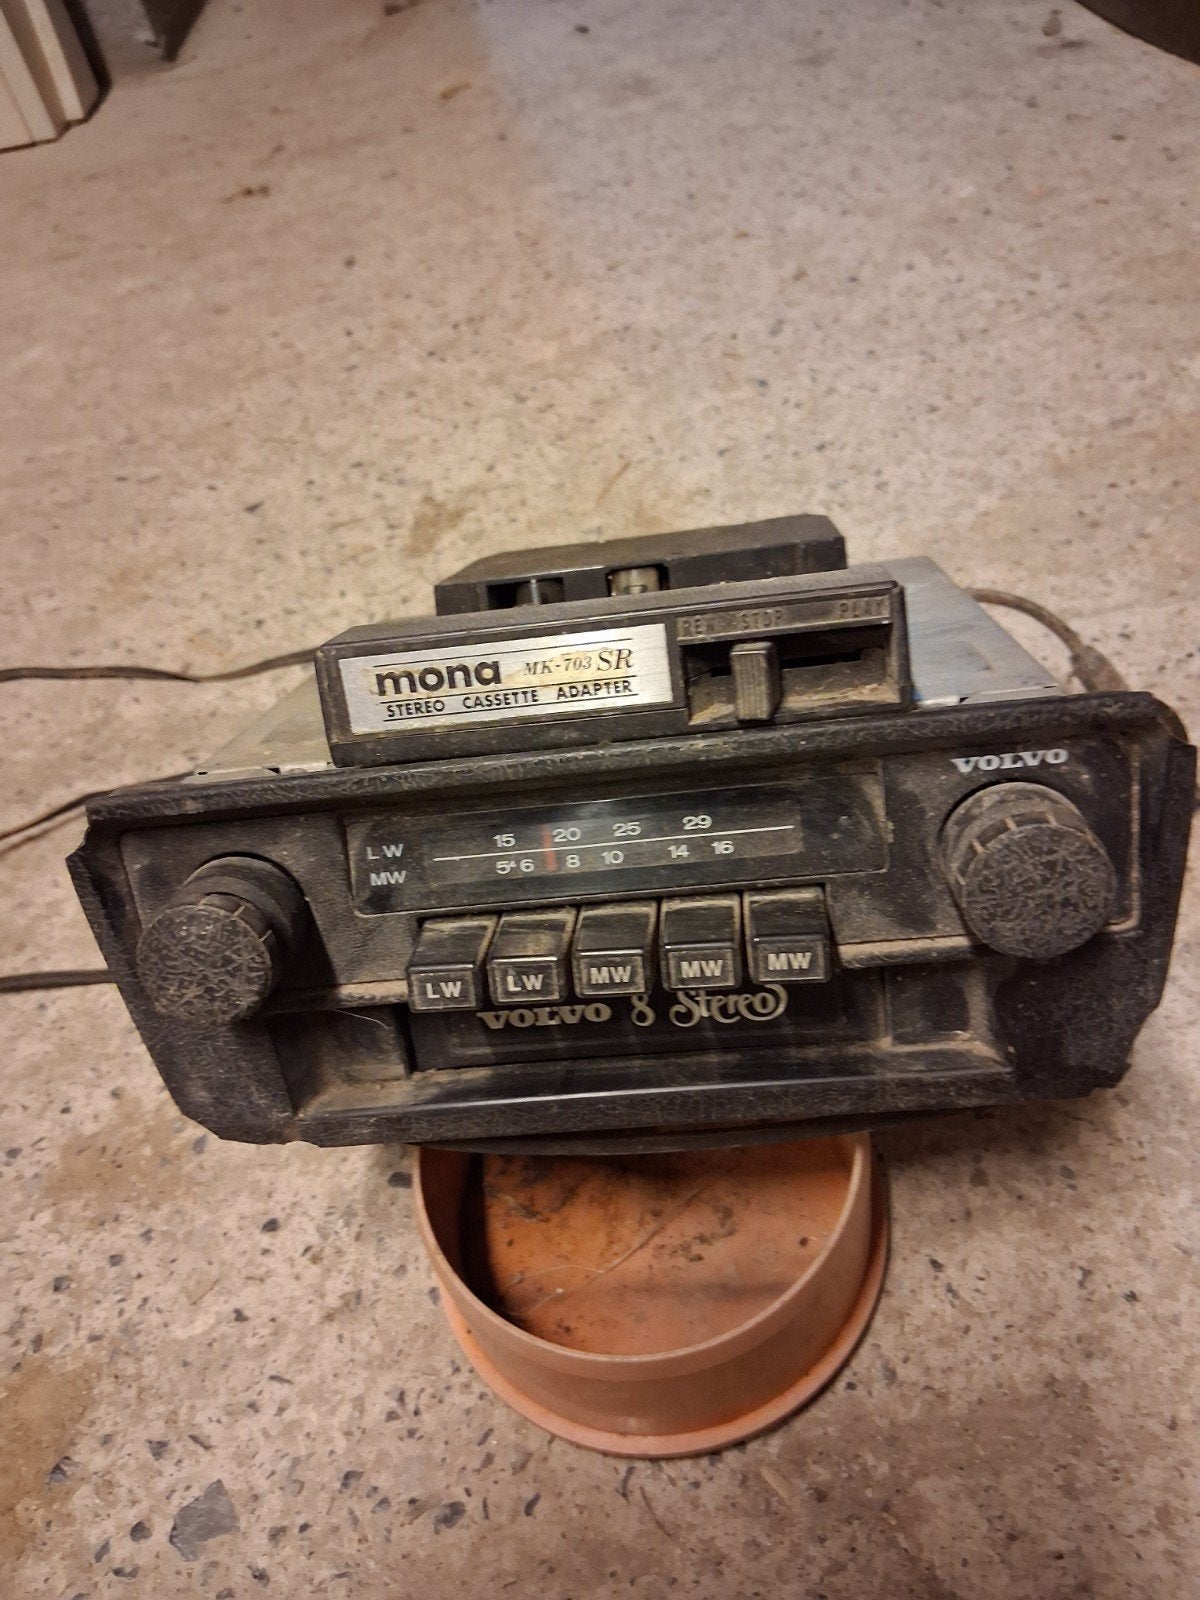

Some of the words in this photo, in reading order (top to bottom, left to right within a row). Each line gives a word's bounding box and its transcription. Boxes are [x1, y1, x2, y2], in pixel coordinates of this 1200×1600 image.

[597, 648, 633, 672] SR
[375, 659, 503, 696] mona
[386, 699, 445, 719] STEREO
[462, 689, 539, 710] CASSETTE
[556, 680, 634, 701] ADAPTER
[951, 748, 1069, 774] VOLVO
[493, 833, 516, 848] 15
[552, 827, 582, 843] 20
[612, 821, 642, 838] 25
[682, 814, 713, 831] 29
[366, 843, 404, 861] LW
[519, 859, 536, 873] 6
[565, 854, 581, 869] 8
[601, 850, 625, 866] 10
[667, 844, 691, 860] 14
[711, 840, 736, 856] 16
[369, 870, 407, 887] MW
[680, 959, 724, 979] MW
[767, 952, 813, 971] MW
[506, 973, 544, 992] LW
[589, 965, 632, 985] MW
[425, 981, 462, 999] LW
[476, 1002, 613, 1030] VOLVO
[630, 993, 657, 1027] 8
[668, 983, 789, 1028] Stereo
